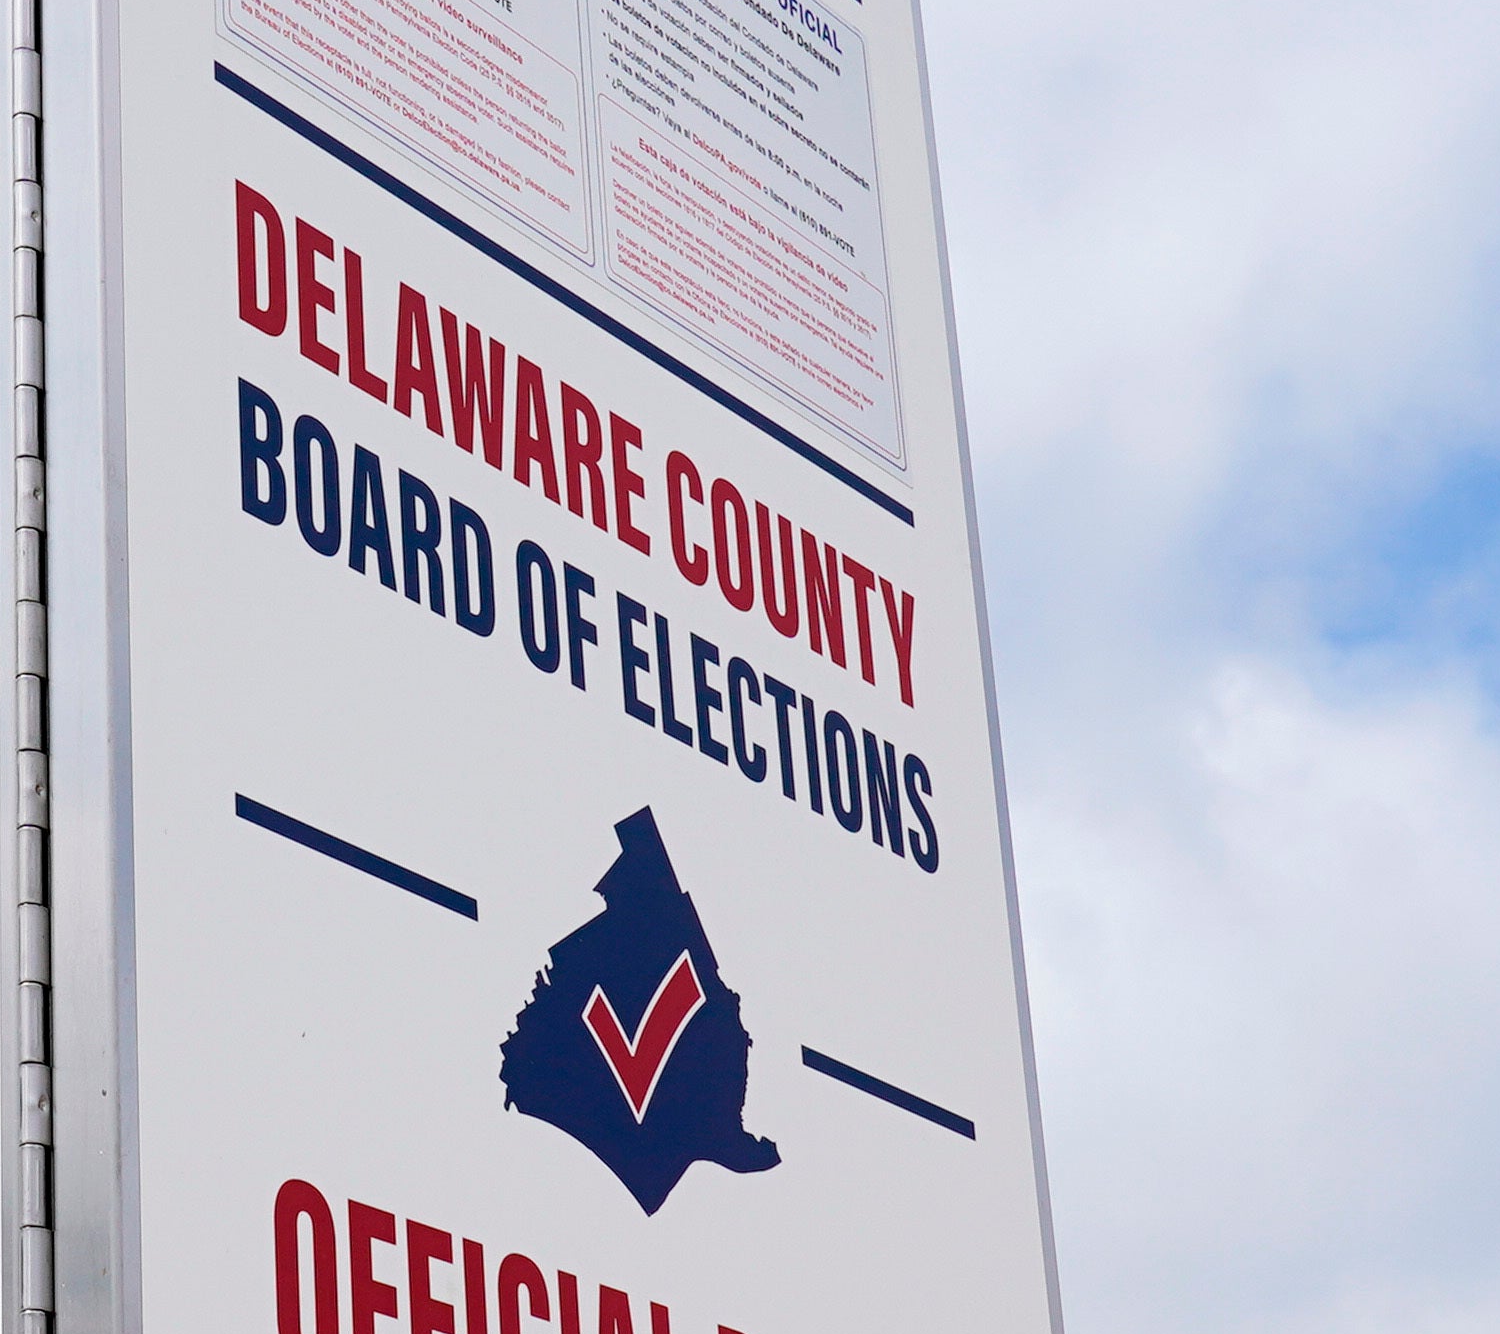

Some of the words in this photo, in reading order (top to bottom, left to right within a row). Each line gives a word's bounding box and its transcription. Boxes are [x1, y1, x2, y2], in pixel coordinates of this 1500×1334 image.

[466, 18, 523, 65] surveillance
[780, 20, 795, 41] De
[796, 32, 841, 77] Delaware
[236, 181, 650, 555] DELAWARE
[667, 451, 914, 706] COUNTY
[238, 377, 495, 637] BOARD
[516, 540, 598, 691] OF
[617, 591, 939, 873] ELECTIONS
